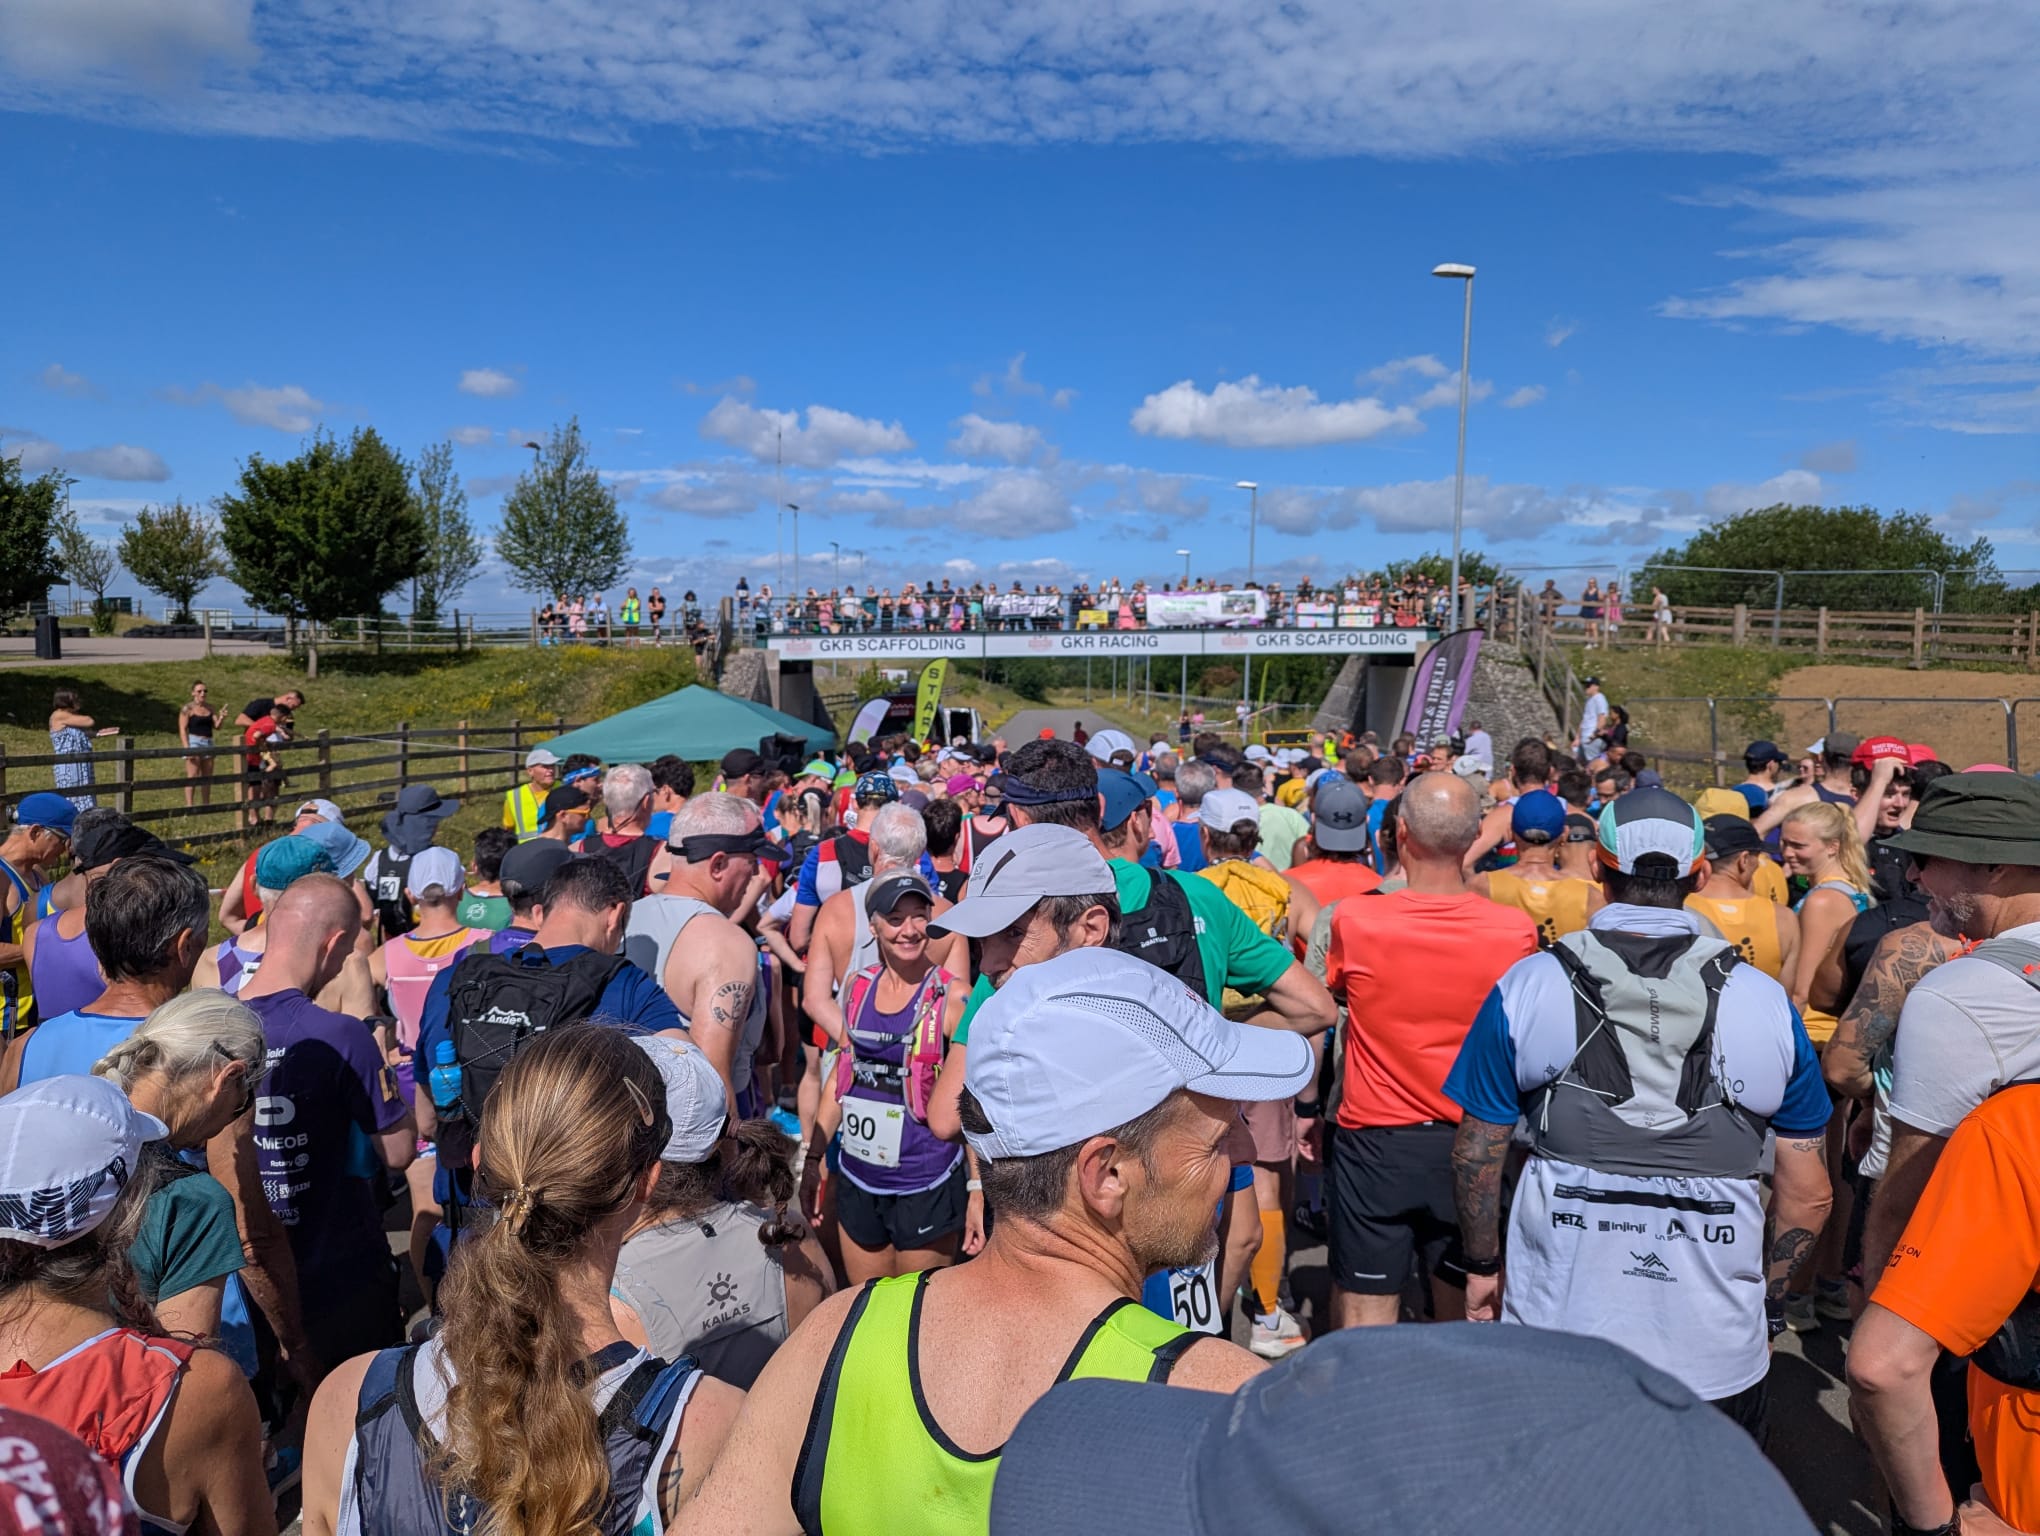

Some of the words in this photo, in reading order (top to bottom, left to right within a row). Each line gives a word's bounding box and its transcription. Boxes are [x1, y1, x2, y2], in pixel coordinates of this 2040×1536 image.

[820, 639, 853, 651] GKR
[858, 638, 966, 651] SCAFFOLDING
[1061, 636, 1095, 648] GKR
[1100, 635, 1159, 648] RACING
[1256, 634, 1290, 646] GKR
[1295, 633, 1407, 646] SCAFFOLDING
[919, 668, 940, 739] START
[1647, 987, 1660, 1045] SALOMON
[266, 1048, 286, 1058] ield
[847, 1113, 876, 1141] 90
[1611, 1222, 1647, 1234] injinji
[702, 1303, 751, 1330] KAILAS
